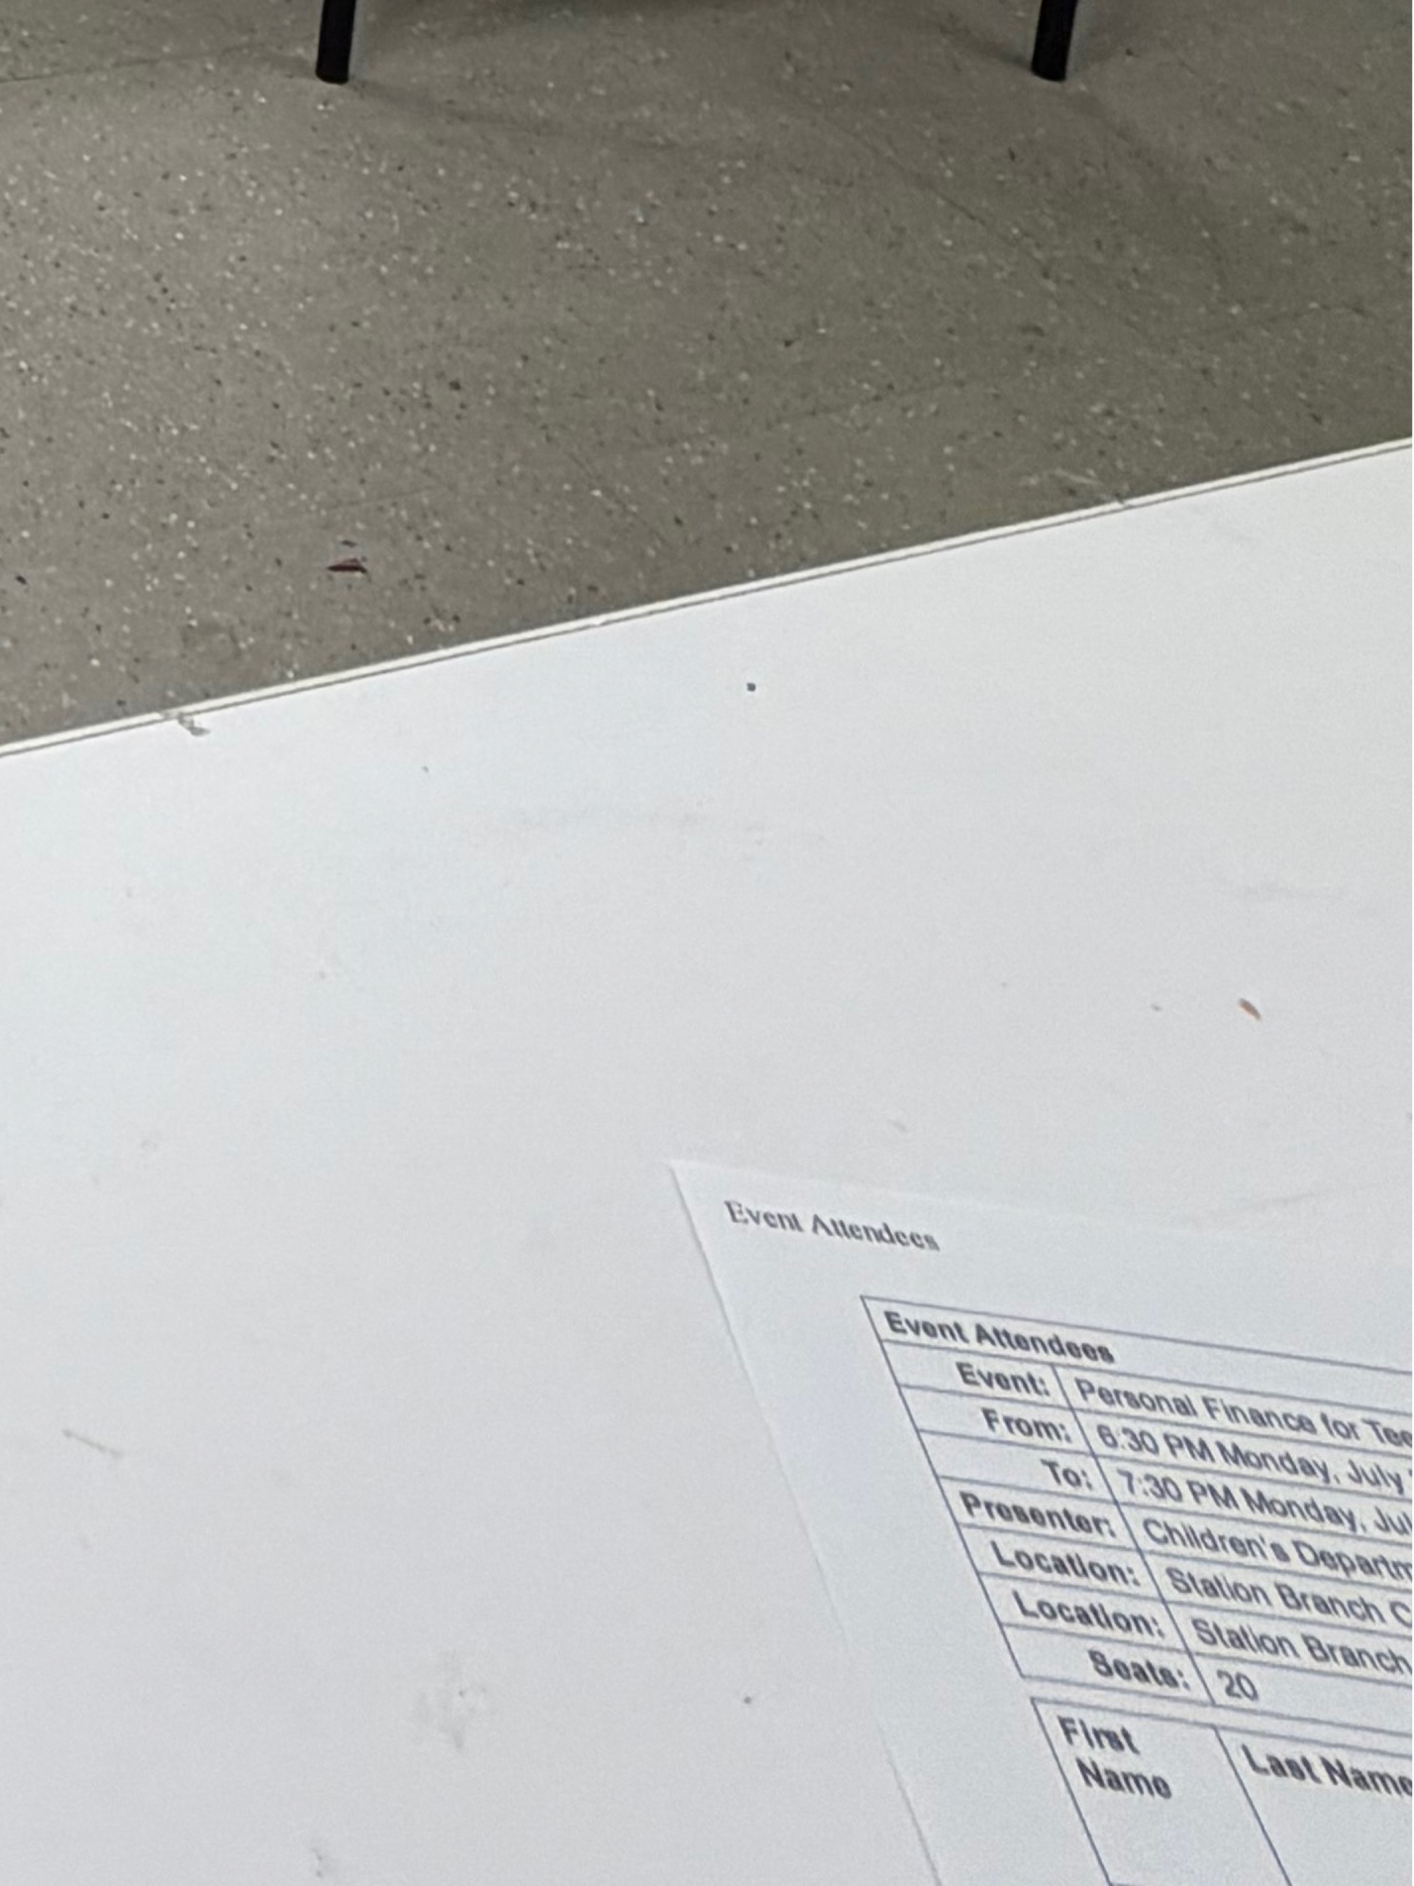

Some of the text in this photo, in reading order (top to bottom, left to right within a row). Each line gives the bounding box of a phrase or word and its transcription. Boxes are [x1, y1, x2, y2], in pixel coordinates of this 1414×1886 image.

[724, 1200, 941, 1251] Event Attendees
[884, 1310, 1115, 1364] Event Attendees
[956, 1362, 1051, 1397] Event:
[1074, 1377, 1199, 1418] Personal
[1202, 1397, 1318, 1436] Finance
[1320, 1412, 1361, 1441] for
[981, 1407, 1404, 1495] From: 6:30 PM Monday, July
[959, 1491, 1117, 1538] Presenter:
[1142, 1518, 1291, 1564] Children's
[1040, 1458, 1094, 1491] To:
[1117, 1469, 1184, 1503] 7:30
[1185, 1479, 1241, 1512] PM
[1239, 1486, 1367, 1534] Monday,
[990, 1540, 1141, 1586] Location:
[1166, 1566, 1272, 1607] Station
[1274, 1581, 1386, 1624] Branch
[1012, 1589, 1412, 1676] Location: Station Branch
[1088, 1649, 1260, 1701] Seats: 20
[1057, 1715, 1141, 1756] First
[1075, 1757, 1173, 1800] Name
[1240, 1744, 1412, 1797] Last Name
